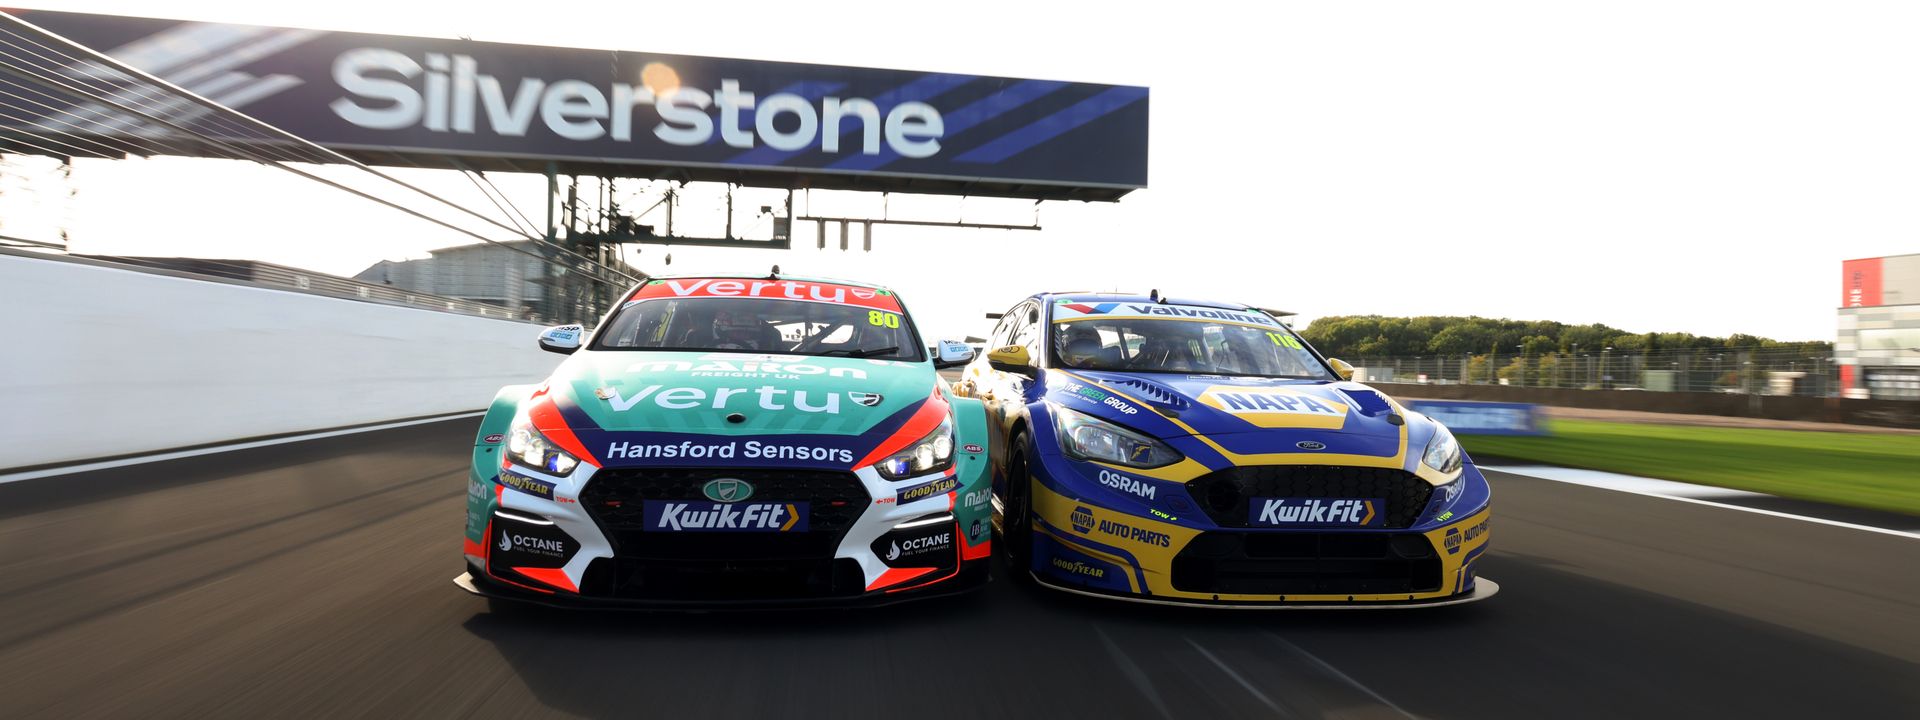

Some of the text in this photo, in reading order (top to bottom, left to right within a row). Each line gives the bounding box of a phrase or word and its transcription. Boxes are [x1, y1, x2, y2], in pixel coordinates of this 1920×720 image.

[329, 46, 945, 160] Silverstone
[867, 309, 899, 330] 80
[1128, 304, 1273, 326] Valvoline
[691, 371, 769, 379] FREIGHT
[1103, 396, 1138, 415] GROUP
[1216, 392, 1336, 413] NAPA
[607, 440, 854, 463] Hansford Sensors
[500, 473, 549, 495] GOODYEAR
[903, 479, 956, 500] GOODYEAR
[1099, 470, 1156, 500] OSRAM
[1149, 508, 1170, 520] TOW
[1073, 512, 1171, 548] NAPA AUTO PARTS
[1464, 524, 1480, 543] AUTO
[513, 534, 563, 553] OCTANE
[902, 532, 950, 551] OCTANE
[1052, 556, 1104, 578] GOODYEAR
